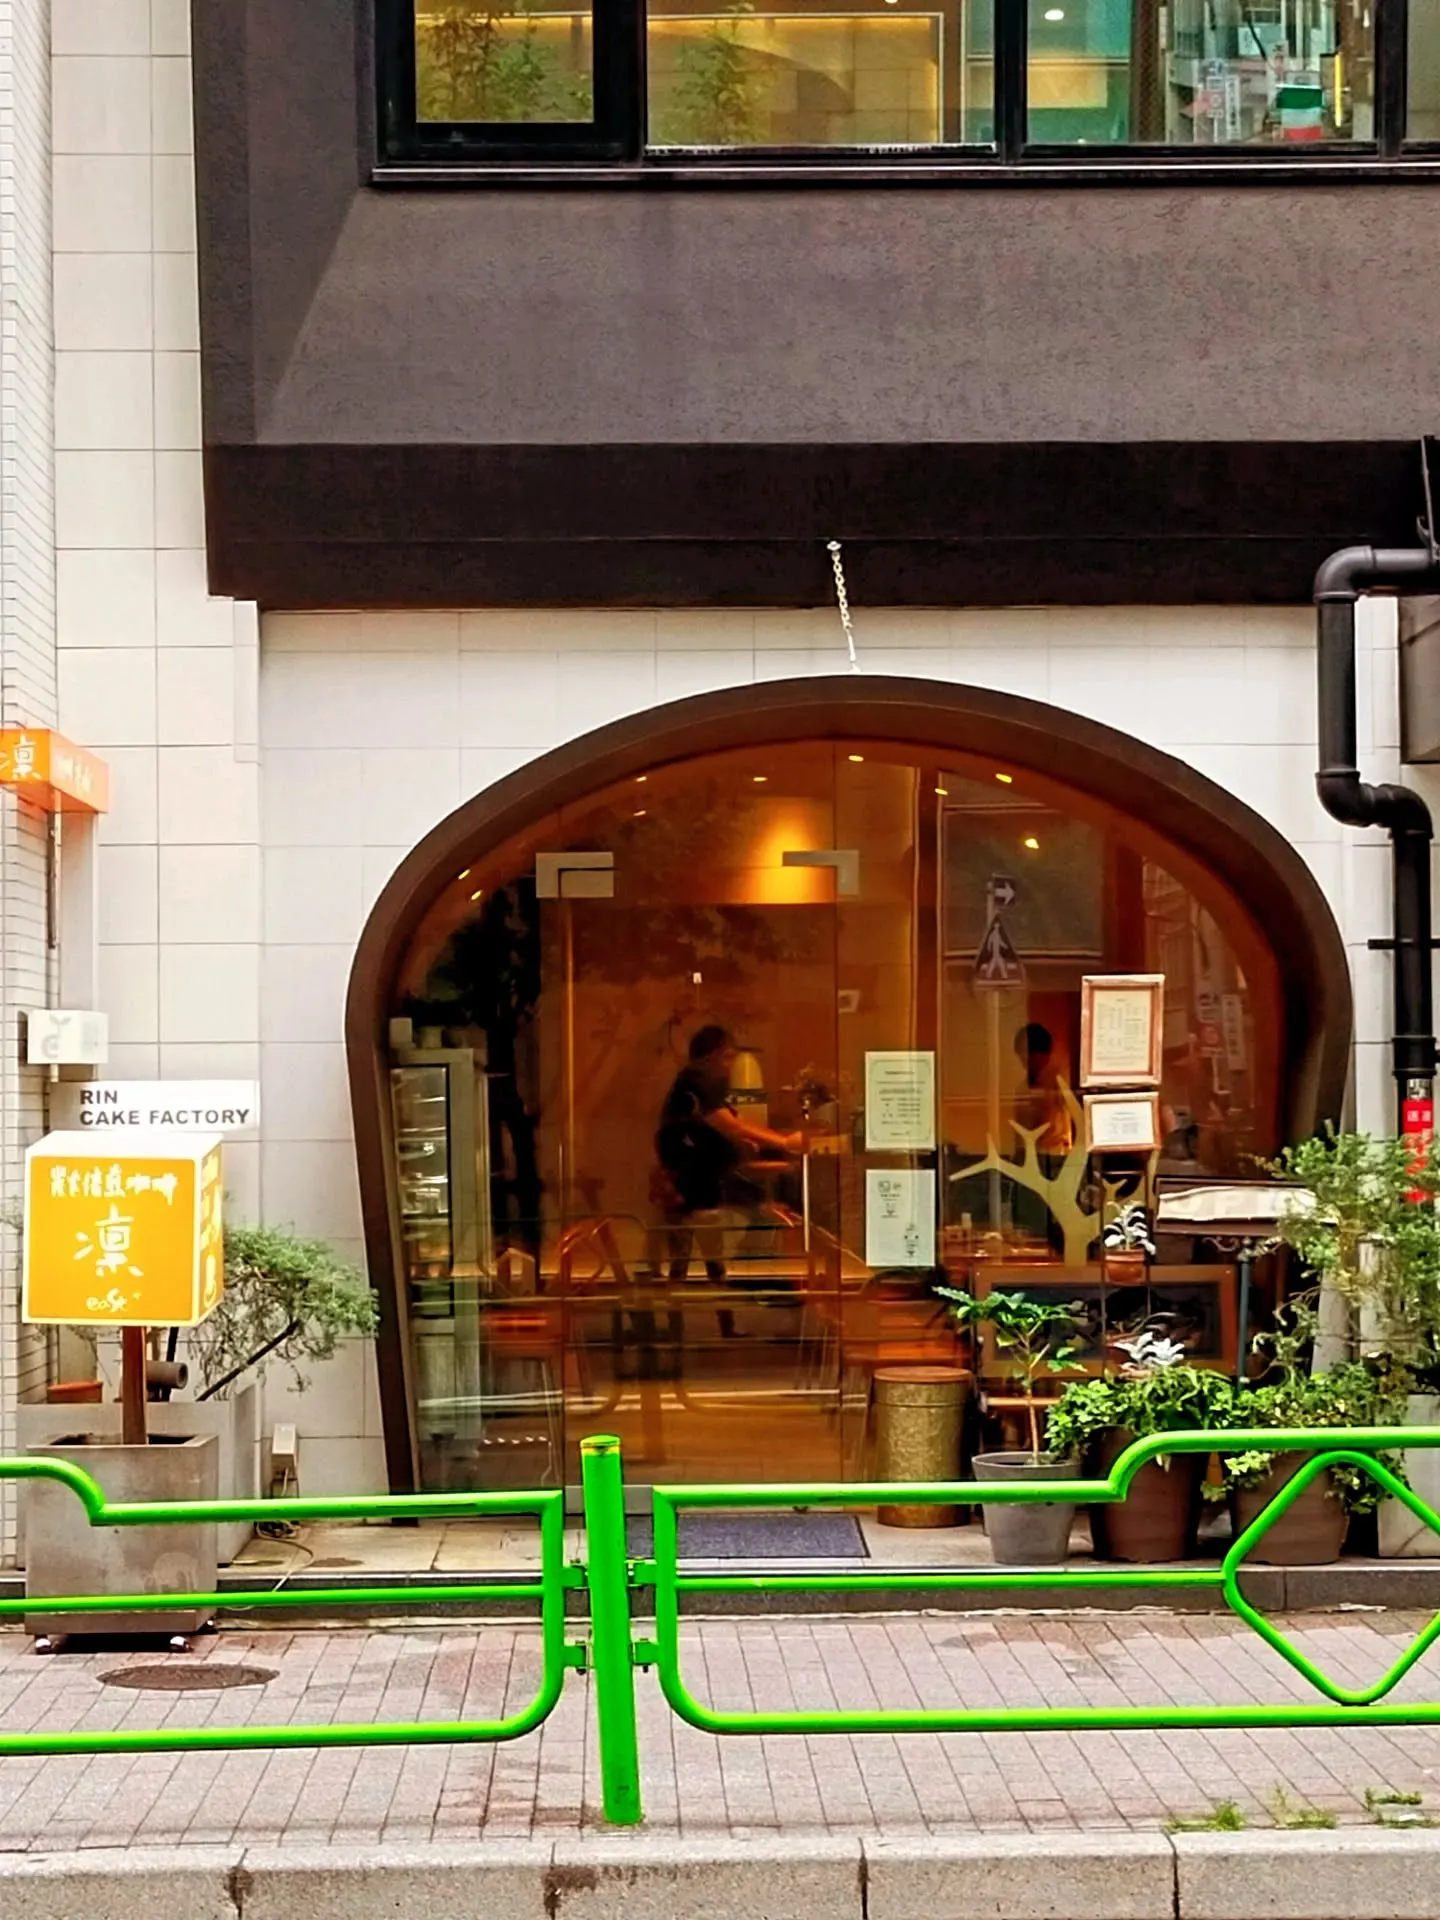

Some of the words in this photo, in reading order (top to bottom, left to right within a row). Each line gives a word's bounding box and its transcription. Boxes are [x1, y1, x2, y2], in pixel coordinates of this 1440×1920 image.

[80, 1090, 118, 1105] RIN
[80, 1110, 140, 1126] CAKE
[149, 1108, 250, 1125] FACTORY
